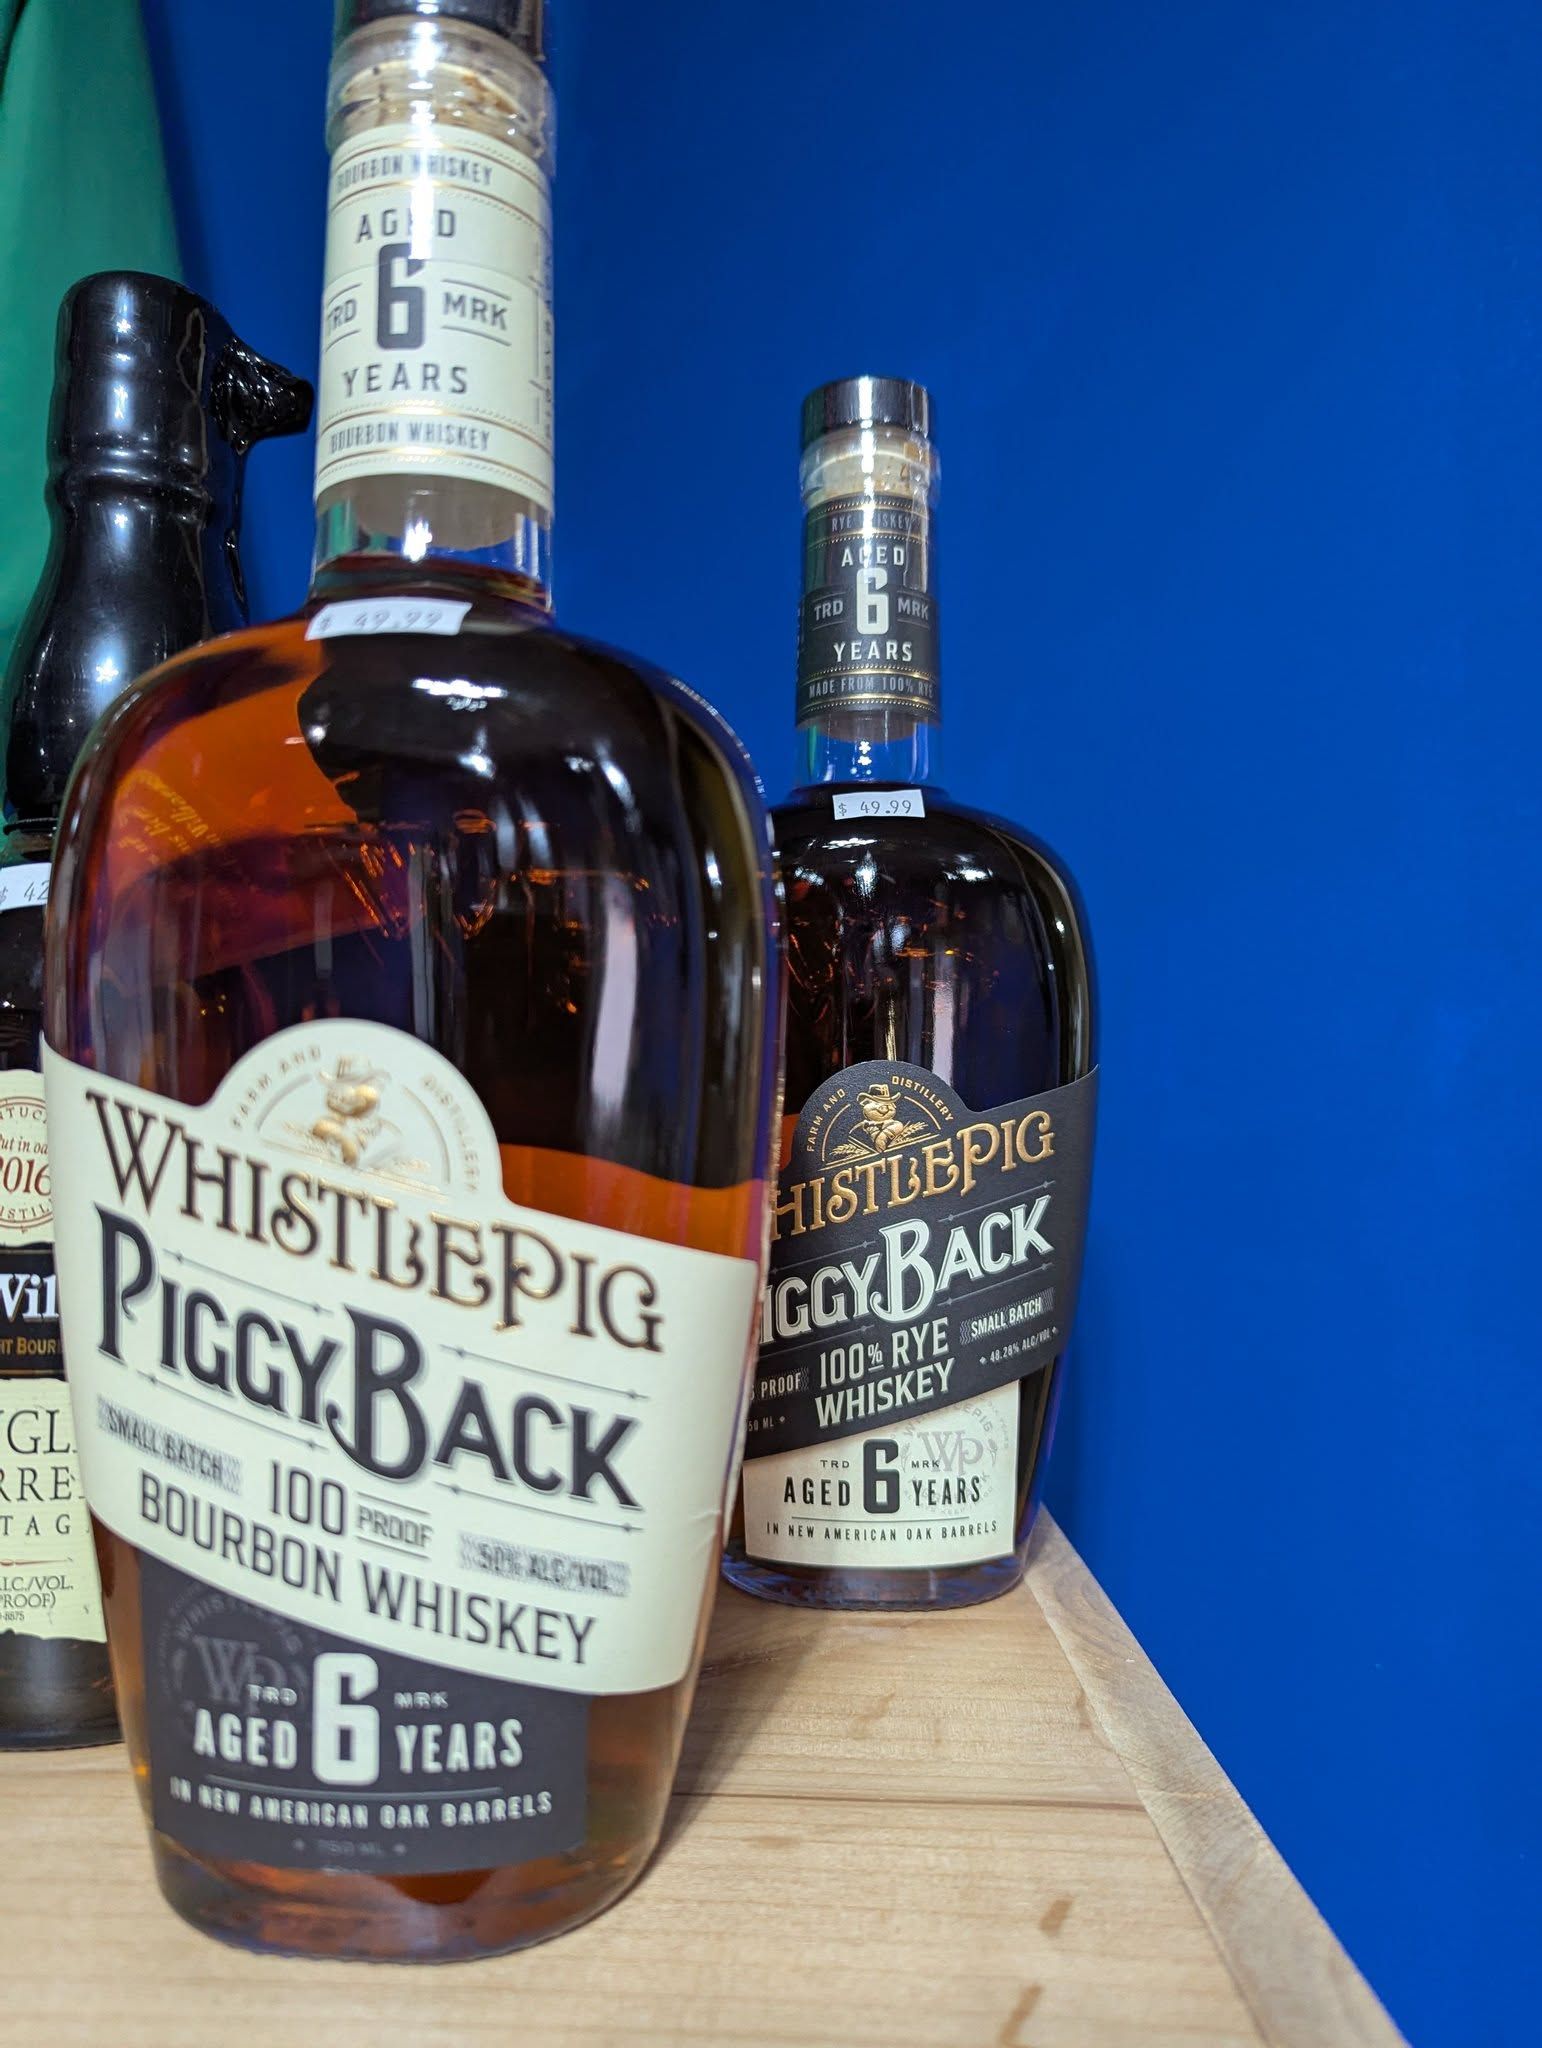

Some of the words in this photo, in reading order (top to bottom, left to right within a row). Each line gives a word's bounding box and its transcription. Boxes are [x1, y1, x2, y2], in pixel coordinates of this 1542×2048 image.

[356, 208, 456, 243] AGD
[377, 243, 425, 350] 6
[442, 291, 507, 331] MRK
[342, 363, 468, 397] YEARS
[330, 422, 407, 455] BOURBON
[409, 422, 490, 451] WHISKEY
[832, 514, 852, 532] RYE
[841, 547, 905, 568] AGED
[814, 600, 843, 621] TRD
[857, 567, 889, 635] 6
[898, 597, 929, 620] MRK
[833, 640, 913, 662] YEARS
[809, 680, 835, 699] MADE
[841, 676, 874, 692] FROM
[882, 676, 913, 693] 100%
[838, 803, 847, 816] $
[860, 800, 911, 814] 49.99
[0, 1106, 47, 1126] TUC
[806, 1115, 823, 1152] FARM
[822, 1088, 846, 1112] AND
[891, 1075, 954, 1121] DISTILLERY
[19, 1136, 30, 1153] in
[0, 1156, 51, 1197] 016
[86, 1089, 664, 1353] WHISTLEPIG
[971, 1312, 1006, 1338] SMALL
[1009, 1297, 1042, 1323] BATCH
[16, 1337, 57, 1356] BOUR
[94, 1201, 644, 1511] PIGGYBACK
[819, 1342, 884, 1390] 100%
[892, 1317, 950, 1368] RYE
[990, 1342, 1020, 1363] 48.28%
[761, 1372, 801, 1398] PROOF
[815, 1358, 955, 1428] WHISKEY
[0, 1409, 77, 1455] GL
[107, 1405, 159, 1453] SMALL
[163, 1430, 224, 1479] BATCH
[784, 1476, 850, 1507] AGED
[912, 1476, 980, 1507] YEARS
[820, 1460, 850, 1469] TRD
[863, 1439, 900, 1514] 6
[911, 1460, 940, 1469] MRK
[271, 1459, 346, 1536] 100
[357, 1504, 433, 1549] PROOF
[0, 1514, 90, 1536] TAG
[767, 1524, 779, 1536] IN
[788, 1526, 815, 1538] NEW
[824, 1530, 897, 1541] AMERICAN
[906, 1529, 932, 1541] OAK
[941, 1520, 997, 1539] BARRELS
[0, 1576, 73, 1591] LC./VOL.
[140, 1469, 342, 1603] BOURBON
[361, 1558, 597, 1664] WHISKEY
[247, 1684, 297, 1706] TRD
[312, 1653, 380, 1785] 6
[394, 1692, 448, 1709] MRK
[193, 1708, 298, 1769] AGED
[395, 1718, 524, 1773] YEARS
[170, 1776, 191, 1803] IN
[199, 1786, 240, 1815] NEW
[250, 1796, 369, 1829] AMERICAN
[380, 1804, 430, 1829] OAK
[441, 1791, 552, 1828] BARRELS
